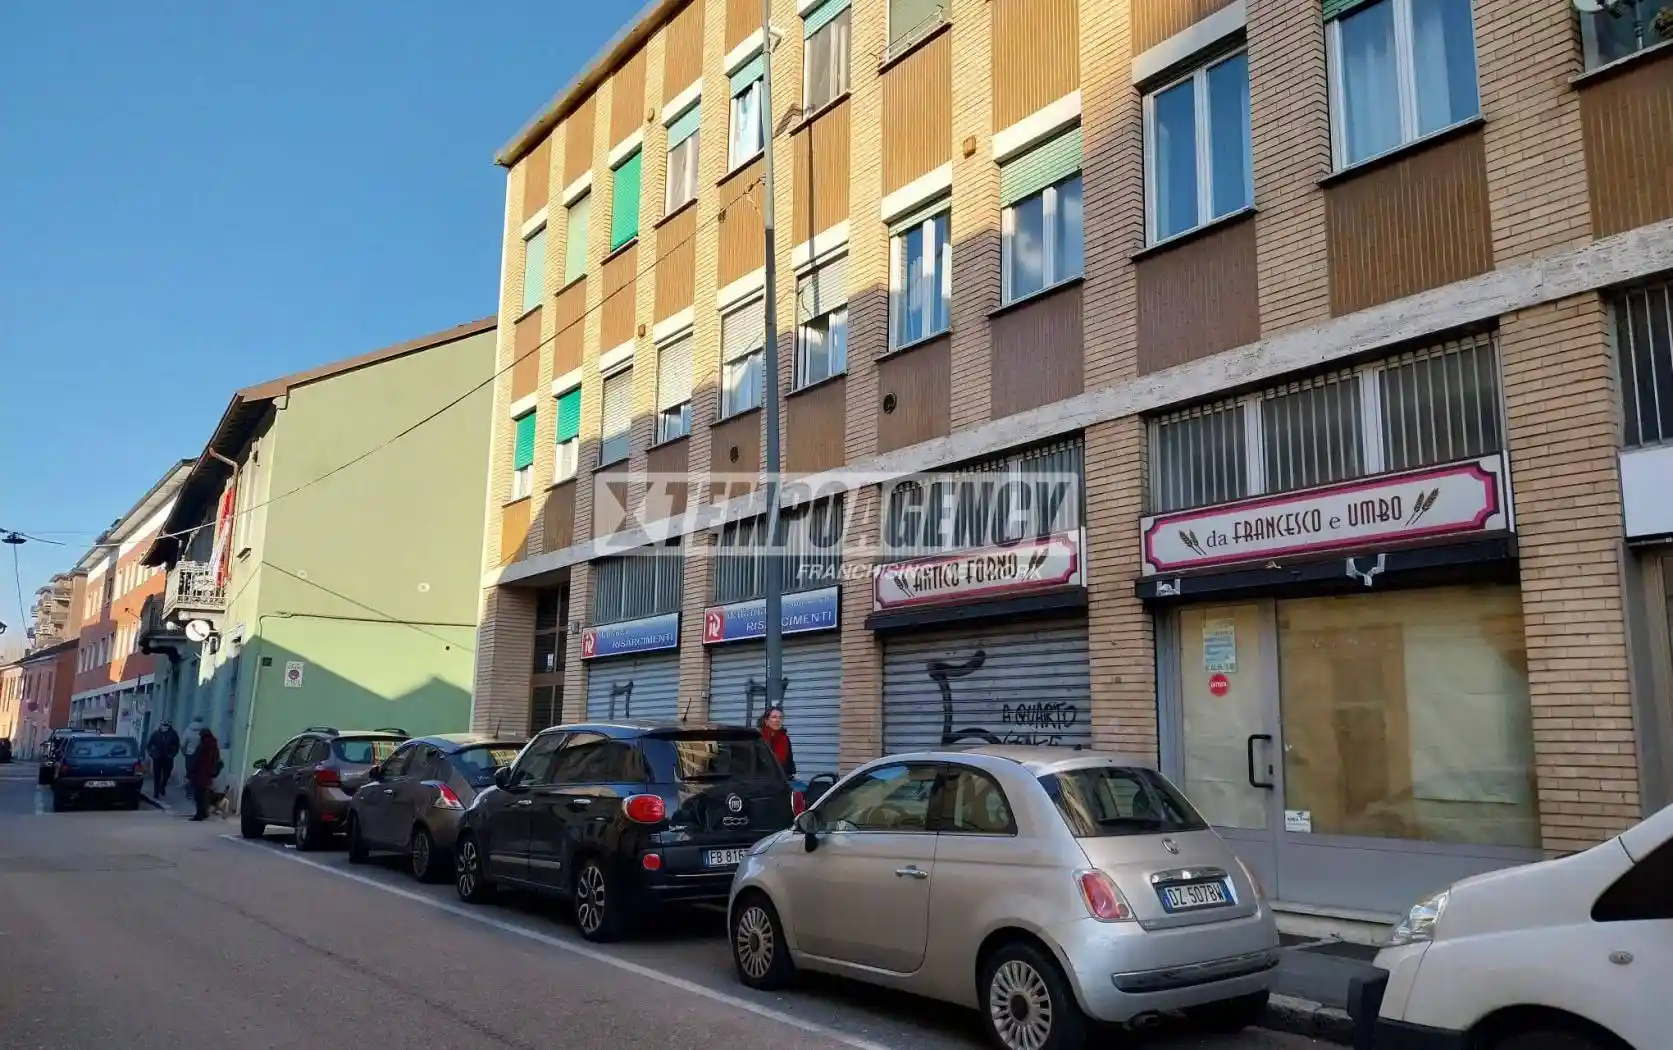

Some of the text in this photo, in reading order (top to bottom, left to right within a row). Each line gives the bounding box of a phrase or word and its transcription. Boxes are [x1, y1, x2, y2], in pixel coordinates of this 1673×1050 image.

[1206, 495, 1403, 549] da FRANCESCO e UMBO
[965, 551, 1019, 585] FORNO
[746, 610, 832, 632] RISCIMENTI
[611, 632, 674, 649] RISARCIMENTI
[1015, 701, 1077, 729] QUARTO
[1167, 887, 1188, 906] DZ
